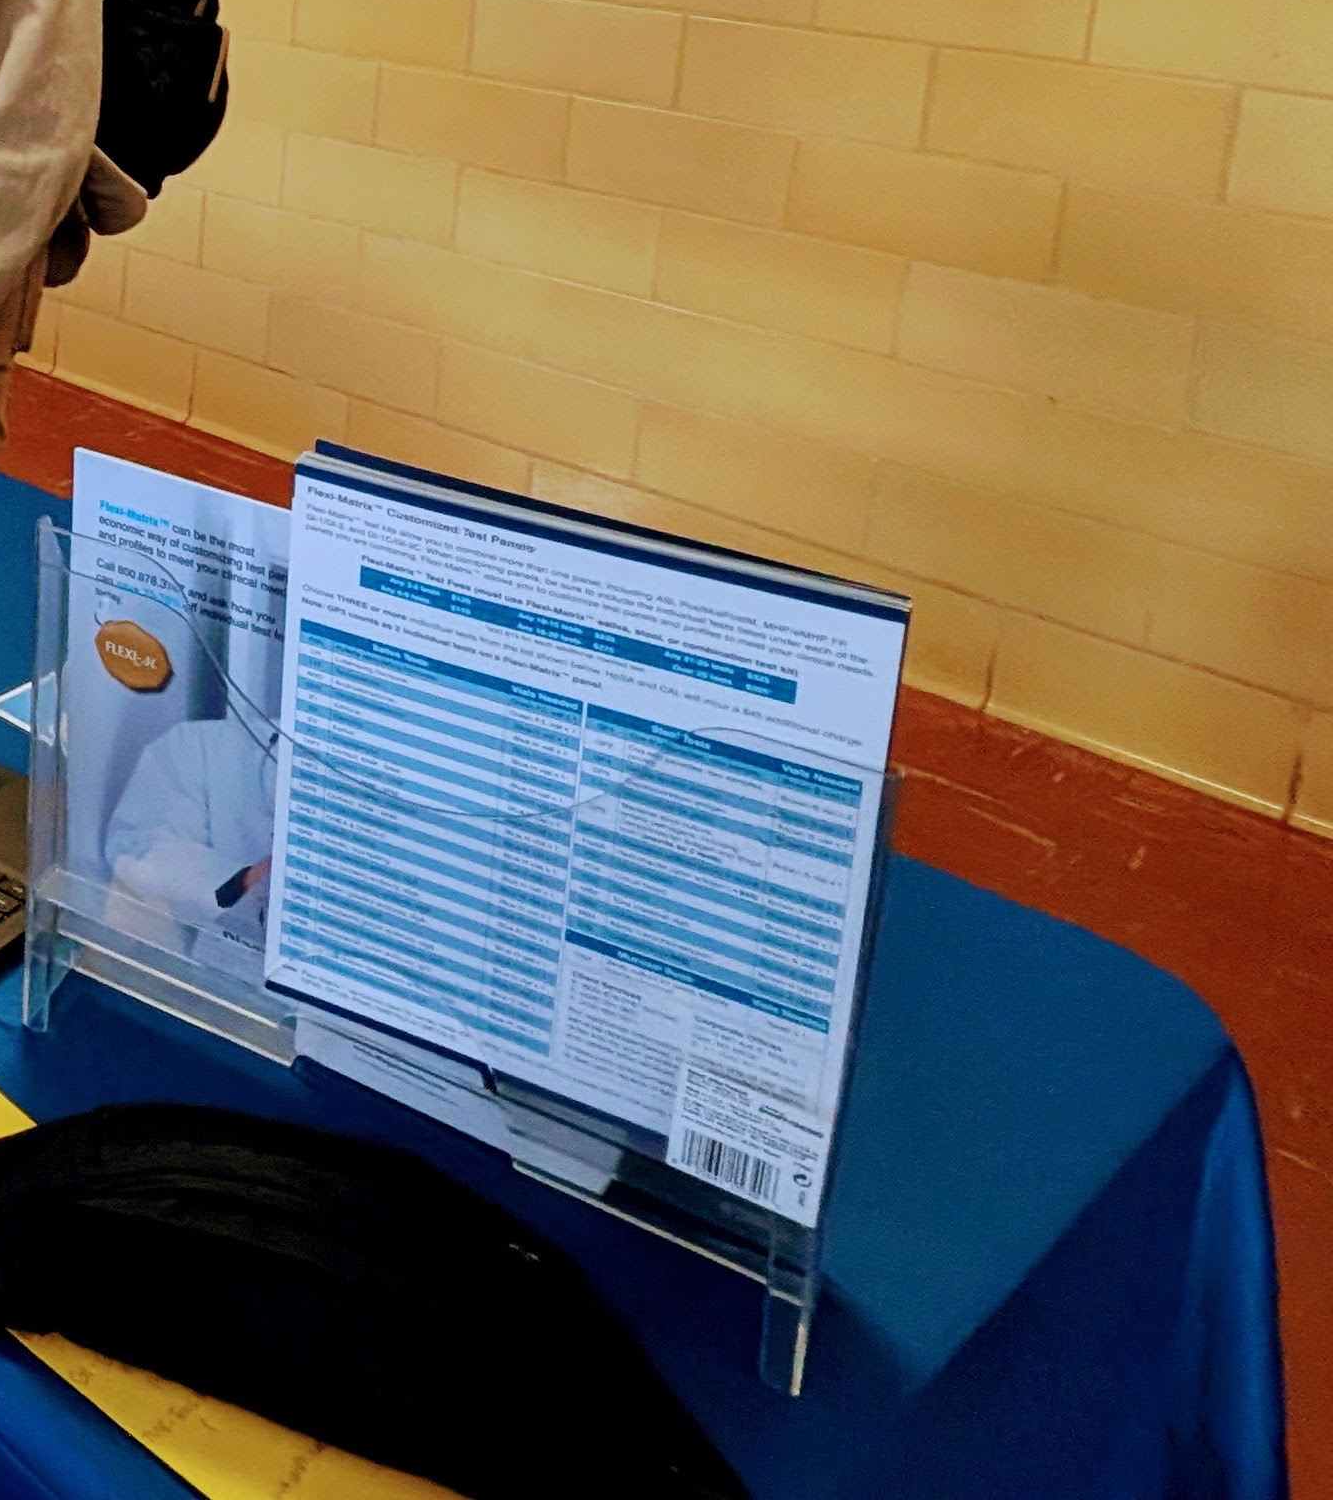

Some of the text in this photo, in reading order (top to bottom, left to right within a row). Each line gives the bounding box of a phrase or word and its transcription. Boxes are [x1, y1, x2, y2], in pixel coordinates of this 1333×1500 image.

[98, 515, 144, 537] economic
[147, 531, 166, 547] way
[170, 536, 179, 549] of
[182, 541, 242, 570] customizing
[245, 558, 264, 575] test
[172, 524, 190, 537] can
[193, 529, 205, 542] be
[209, 533, 224, 548] the
[228, 540, 254, 557] most
[386, 506, 457, 534] Customized
[463, 526, 487, 542] Test
[98, 530, 116, 542] and
[118, 537, 153, 555] profiles
[156, 546, 165, 558] to
[168, 552, 193, 568] meet
[196, 562, 218, 575] your
[222, 568, 257, 588] clinical
[95, 572, 113, 585] can
[251, 621, 271, 637] test
[96, 557, 115, 571] Call
[188, 587, 206, 601] and
[231, 600, 251, 616] how
[256, 610, 275, 624] you
